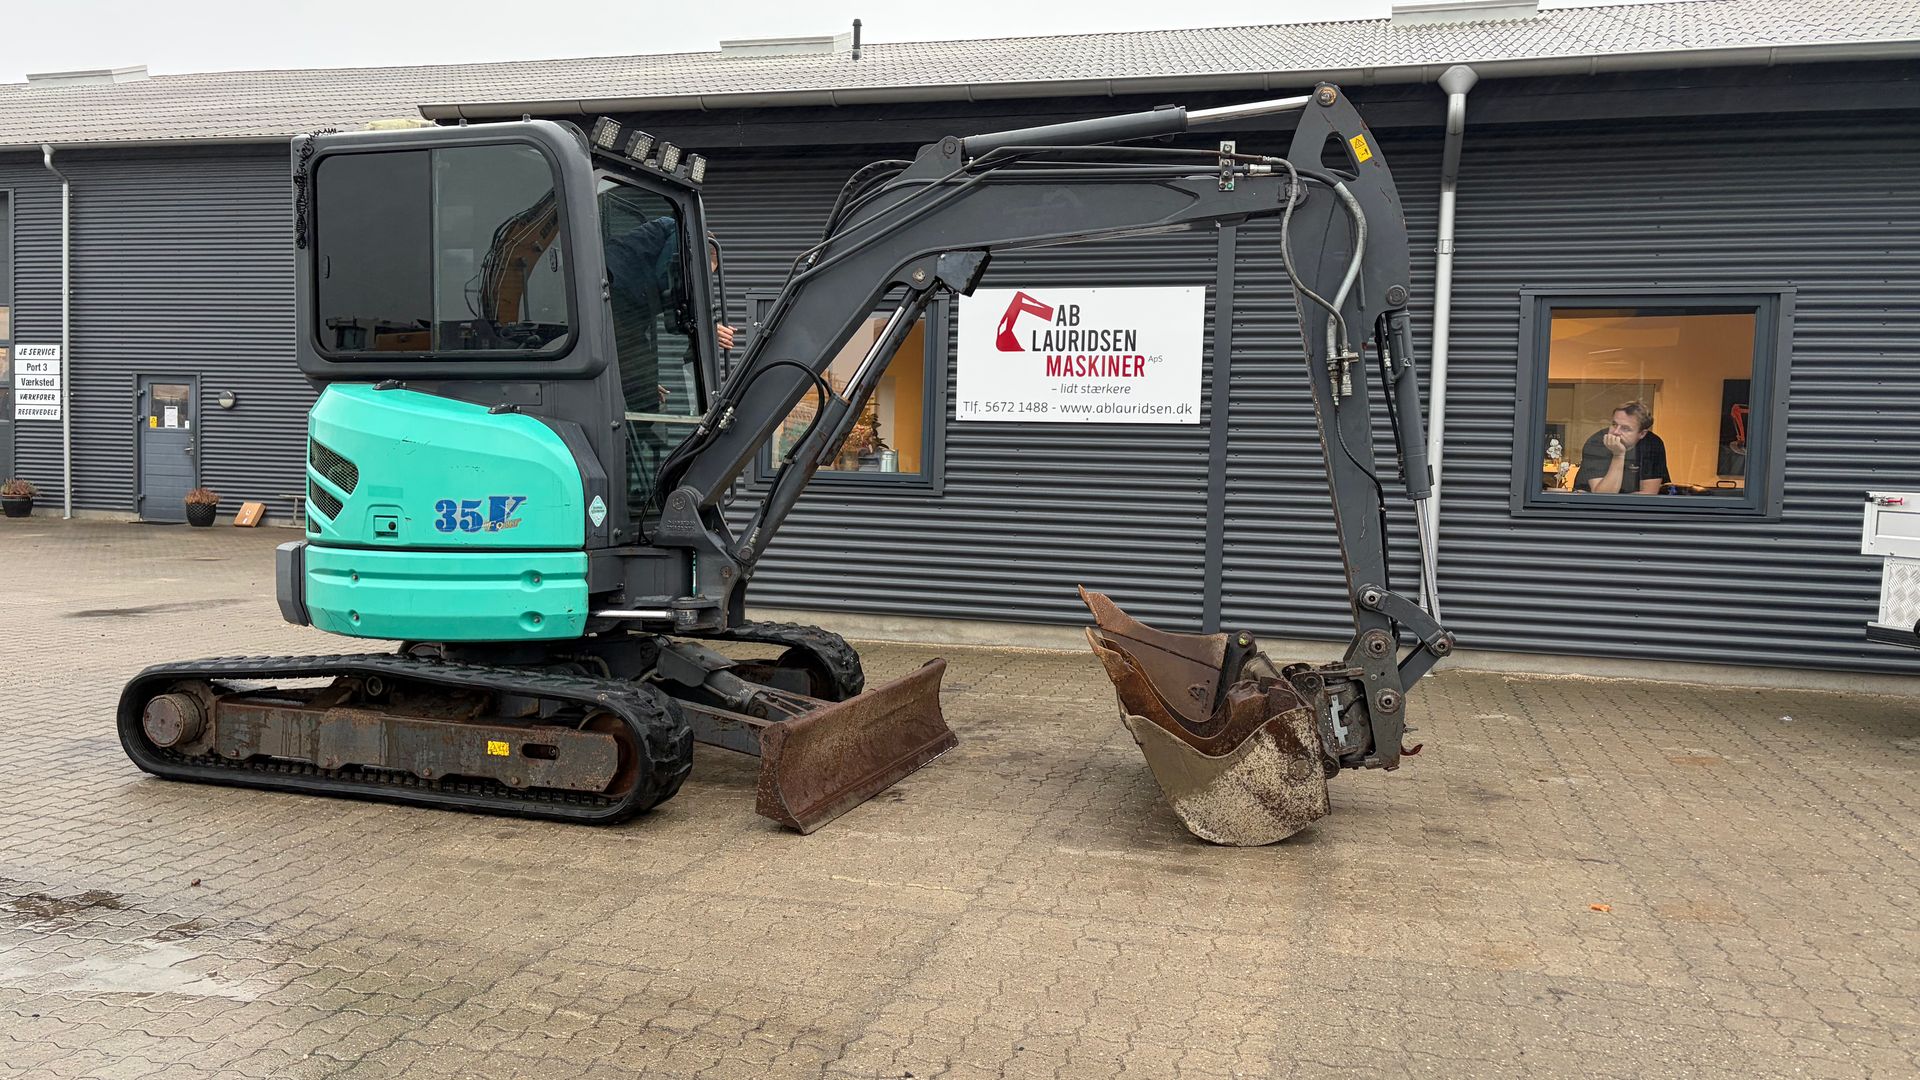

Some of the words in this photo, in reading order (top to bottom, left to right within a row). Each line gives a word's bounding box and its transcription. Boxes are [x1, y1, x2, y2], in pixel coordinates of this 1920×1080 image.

[1055, 304, 1081, 327] AB
[1031, 329, 1137, 352] LAURIDSEN
[26, 363, 41, 371] Port
[43, 363, 48, 371] 3
[1045, 354, 1145, 378] MASKINER
[1147, 355, 1164, 364] ApS
[21, 378, 54, 386] Værksted
[1060, 383, 1079, 394] lidt
[1080, 383, 1132, 395] stærkere
[963, 400, 981, 414] Tlf.
[985, 401, 1015, 413] 5672
[1018, 402, 1049, 413] 1488
[1059, 402, 1193, 415] www.ablauridsen.dk
